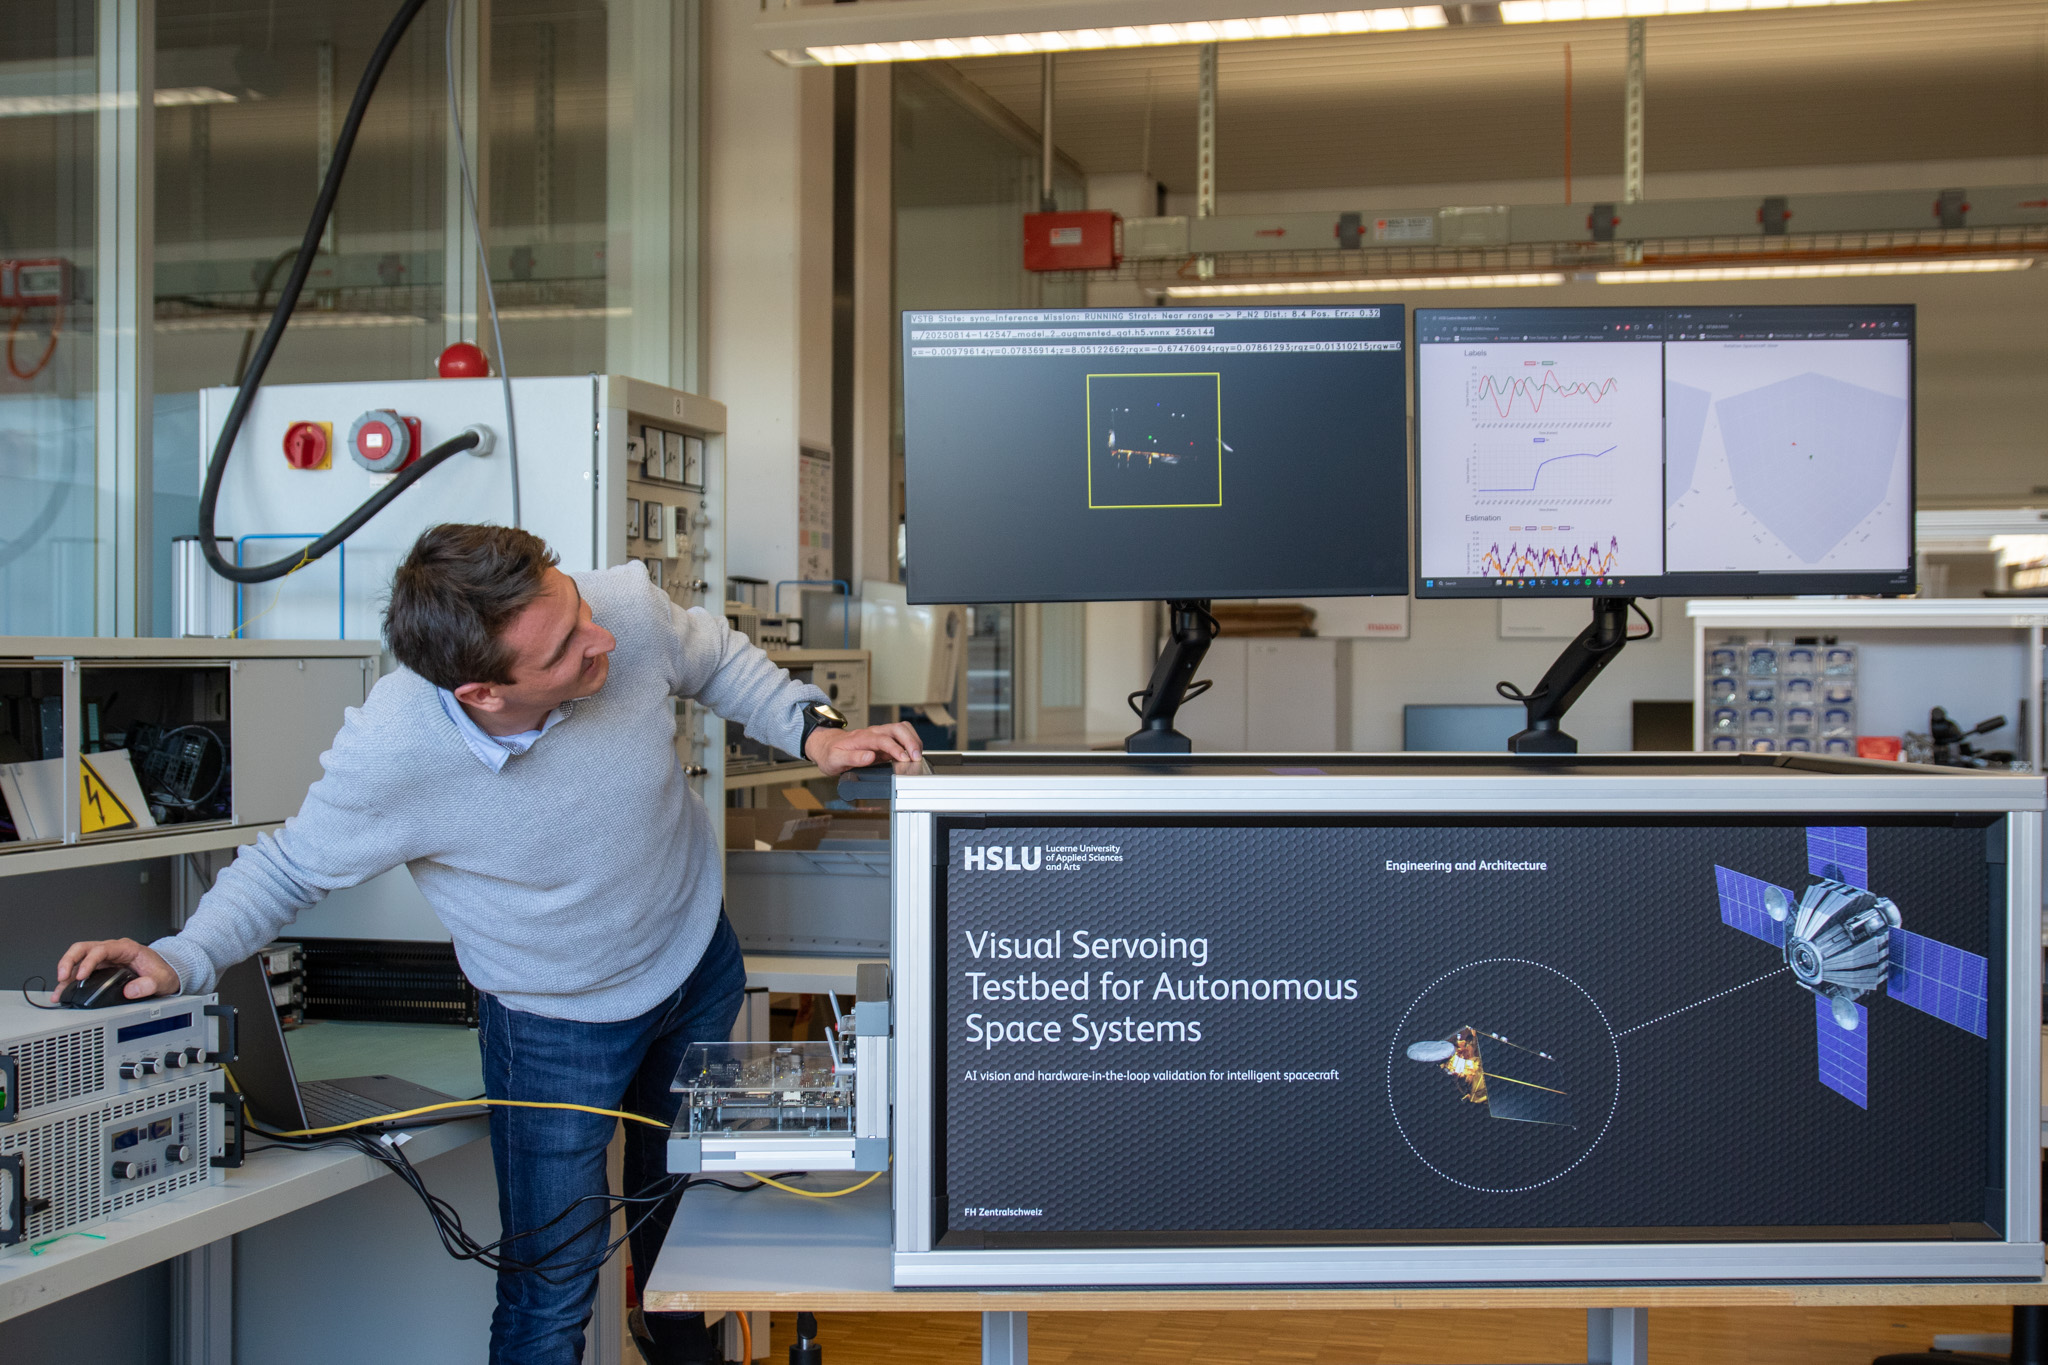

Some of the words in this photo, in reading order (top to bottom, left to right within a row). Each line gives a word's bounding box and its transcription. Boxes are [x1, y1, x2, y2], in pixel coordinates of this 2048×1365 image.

[911, 314, 934, 323] VSTB
[939, 314, 965, 322] State:
[970, 313, 1039, 323] sync_inference
[1043, 313, 1080, 321] Mission:
[1084, 312, 1124, 320] RUNNING
[1128, 312, 1157, 320] Strat.:
[1161, 311, 1183, 319] Near
[1263, 310, 1288, 318] Dist.:
[1291, 310, 1306, 318] 8.4
[1311, 310, 1330, 318] Pos.
[1334, 309, 1355, 317] Err.:
[1359, 309, 1380, 317] 0.32
[1175, 328, 1214, 336] 256x144
[1464, 349, 1487, 357] Labels
[675, 399, 681, 415] 8
[1465, 514, 1502, 522] Estimation
[1367, 623, 1402, 631] maxon
[1046, 844, 1078, 852] Lucerne
[1080, 844, 1120, 854] University
[964, 845, 1042, 871] HSLU
[1056, 854, 1087, 863] Applied
[1089, 854, 1123, 862] Sciences
[1046, 863, 1062, 871] and
[1063, 863, 1081, 871] Arts
[1385, 860, 1452, 873] Engineering
[1455, 860, 1476, 871] and
[1479, 860, 1547, 871] Architecture
[965, 930, 1061, 959] Visual
[1072, 930, 1208, 966] Servoing
[965, 971, 1089, 1001] Testbed
[1100, 971, 1144, 1000] for
[1152, 971, 1358, 1001] Autonomous
[965, 1013, 1061, 1050] Space
[1072, 1013, 1202, 1050] Systems
[964, 1070, 978, 1081] AI
[980, 1070, 1011, 1081] vision
[1014, 1070, 1035, 1081] and
[1038, 1070, 1150, 1083] hardware-in-the-loop
[1153, 1070, 1206, 1081] validation
[1209, 1070, 1224, 1081] for
[1227, 1070, 1281, 1083] intelligent
[1283, 1069, 1340, 1083] spacecraft
[964, 1208, 976, 1216] FH
[979, 1207, 1043, 1216] Zentralschweiz
